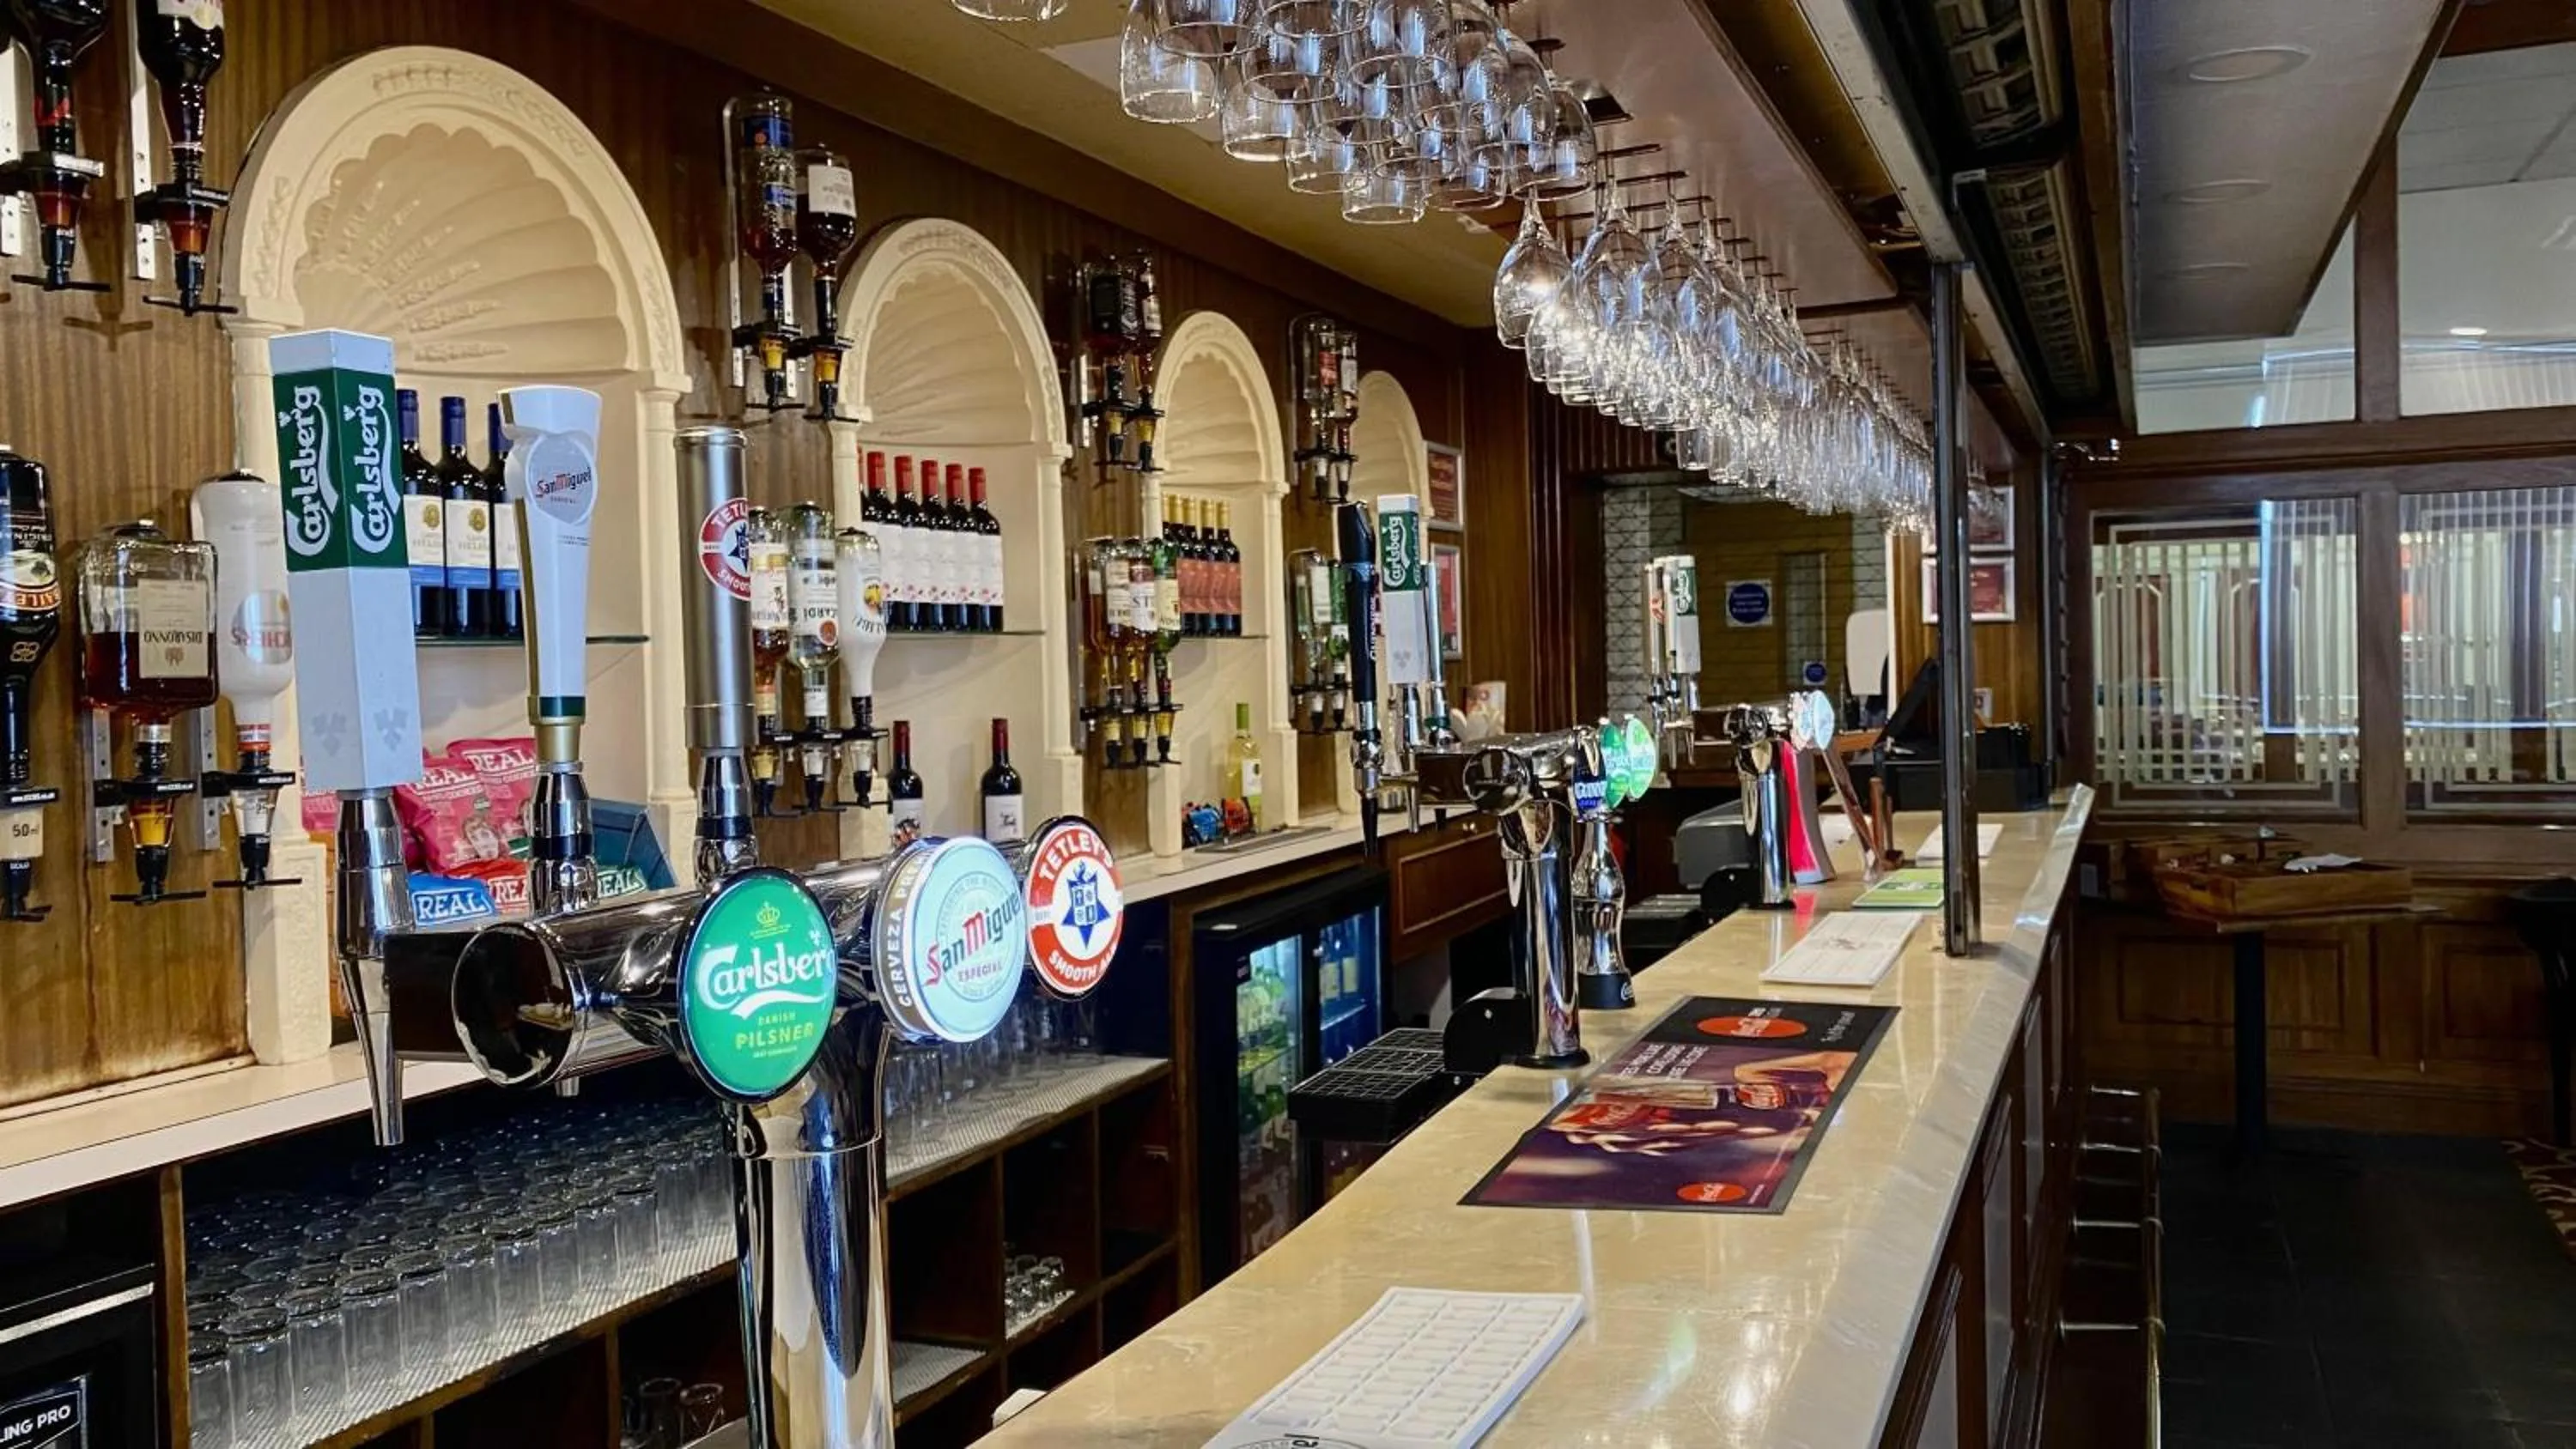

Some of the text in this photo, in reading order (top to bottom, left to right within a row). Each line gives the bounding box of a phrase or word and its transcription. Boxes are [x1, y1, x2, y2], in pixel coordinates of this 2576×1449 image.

[284, 385, 337, 556] Carlsberg
[349, 383, 401, 554] Carlsberg
[1383, 515, 1409, 587] Carlsberg
[465, 749, 534, 772] REAL
[598, 868, 639, 898] EAL
[417, 893, 485, 920] REAL
[887, 906, 913, 1008] CERVEZA
[1048, 949, 1097, 982] SMOOTH
[758, 1009, 796, 1027] DANISH
[735, 1022, 814, 1051] PILSNER
[37, 1404, 71, 1429] PRO
